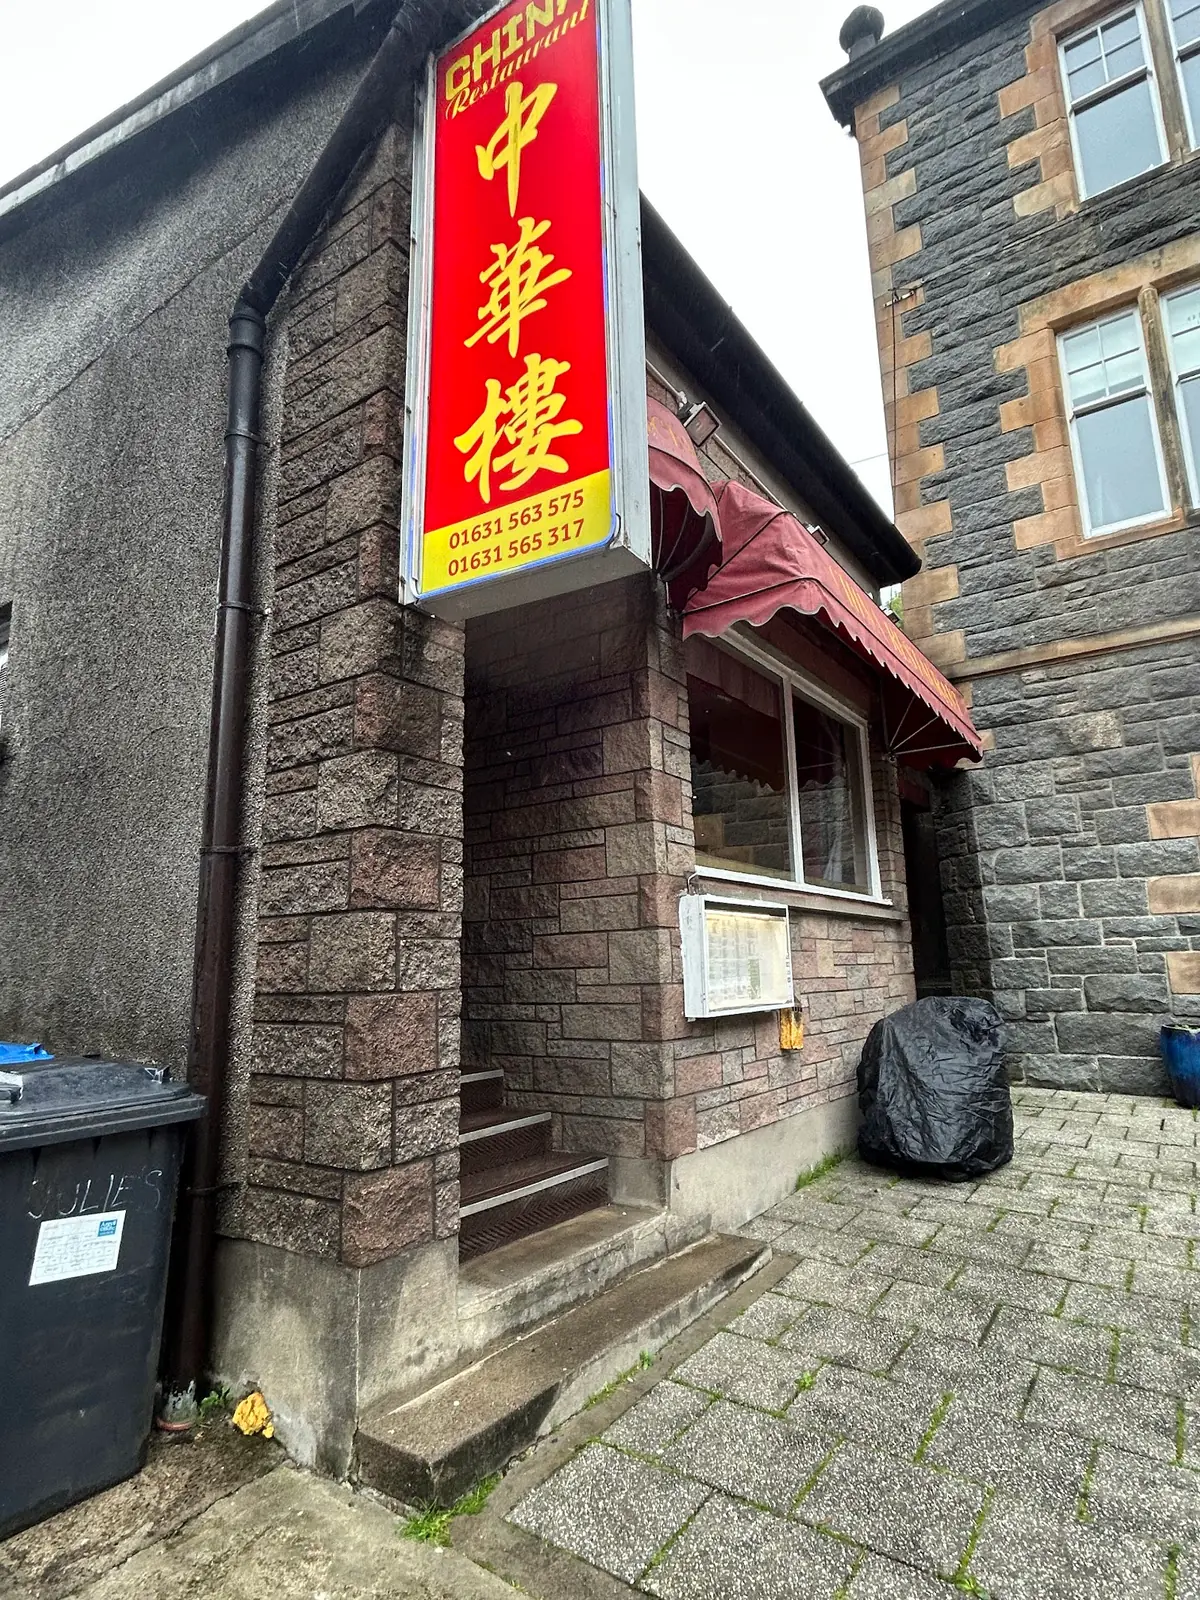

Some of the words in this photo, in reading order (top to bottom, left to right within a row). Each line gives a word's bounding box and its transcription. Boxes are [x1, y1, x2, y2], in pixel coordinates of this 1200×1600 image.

[445, 0, 589, 120] Restaurant
[453, 81, 583, 504] 中華樓
[447, 545, 503, 577] 01631
[507, 531, 542, 559] 565
[547, 518, 585, 547] 317
[449, 517, 504, 550] 01631
[508, 503, 542, 531] 563
[547, 488, 584, 517] 575
